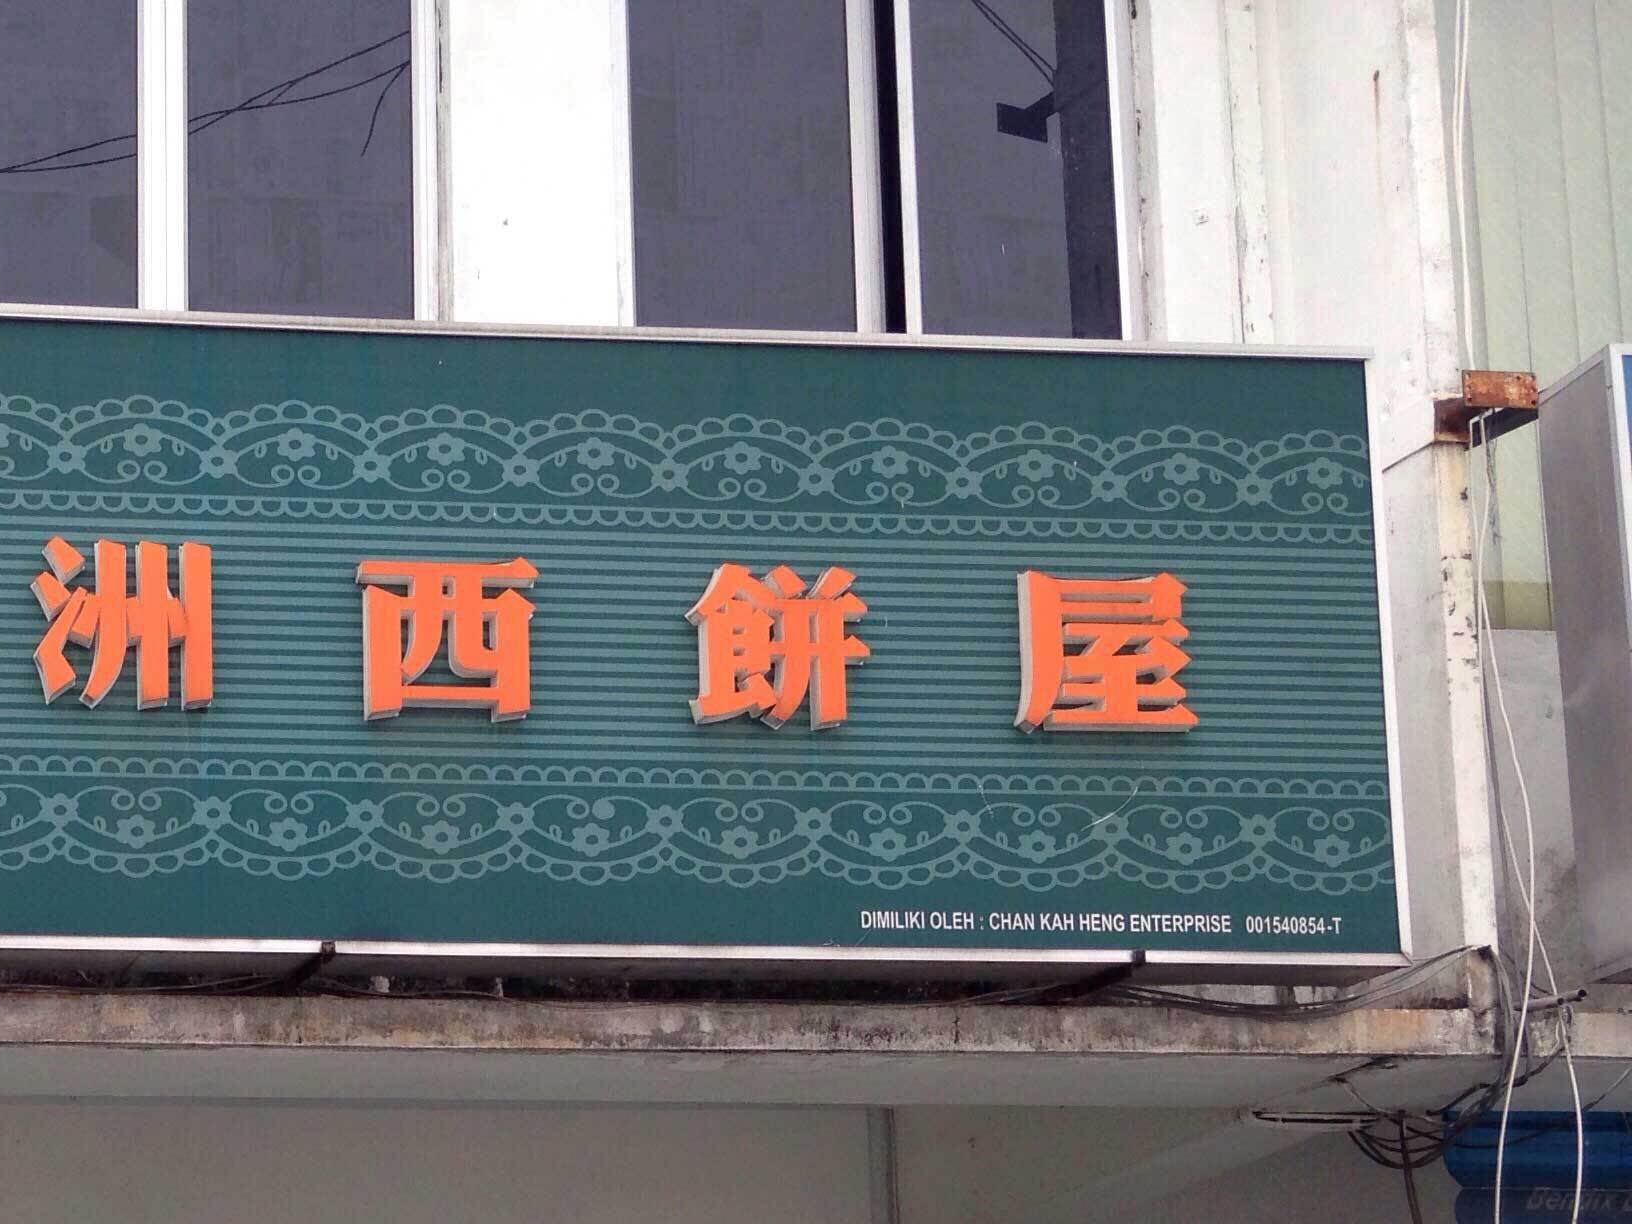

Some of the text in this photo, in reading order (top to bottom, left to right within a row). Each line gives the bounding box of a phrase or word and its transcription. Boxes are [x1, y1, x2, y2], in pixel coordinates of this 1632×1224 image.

[860, 910, 926, 930] DIMILIKI
[930, 911, 975, 930] OLEH
[989, 912, 1035, 931] CHAN
[1039, 912, 1075, 932] KAH
[1079, 913, 1125, 932] HENG
[1129, 914, 1233, 934] ENTERPRISE
[1245, 915, 1343, 935] 001540854-T
